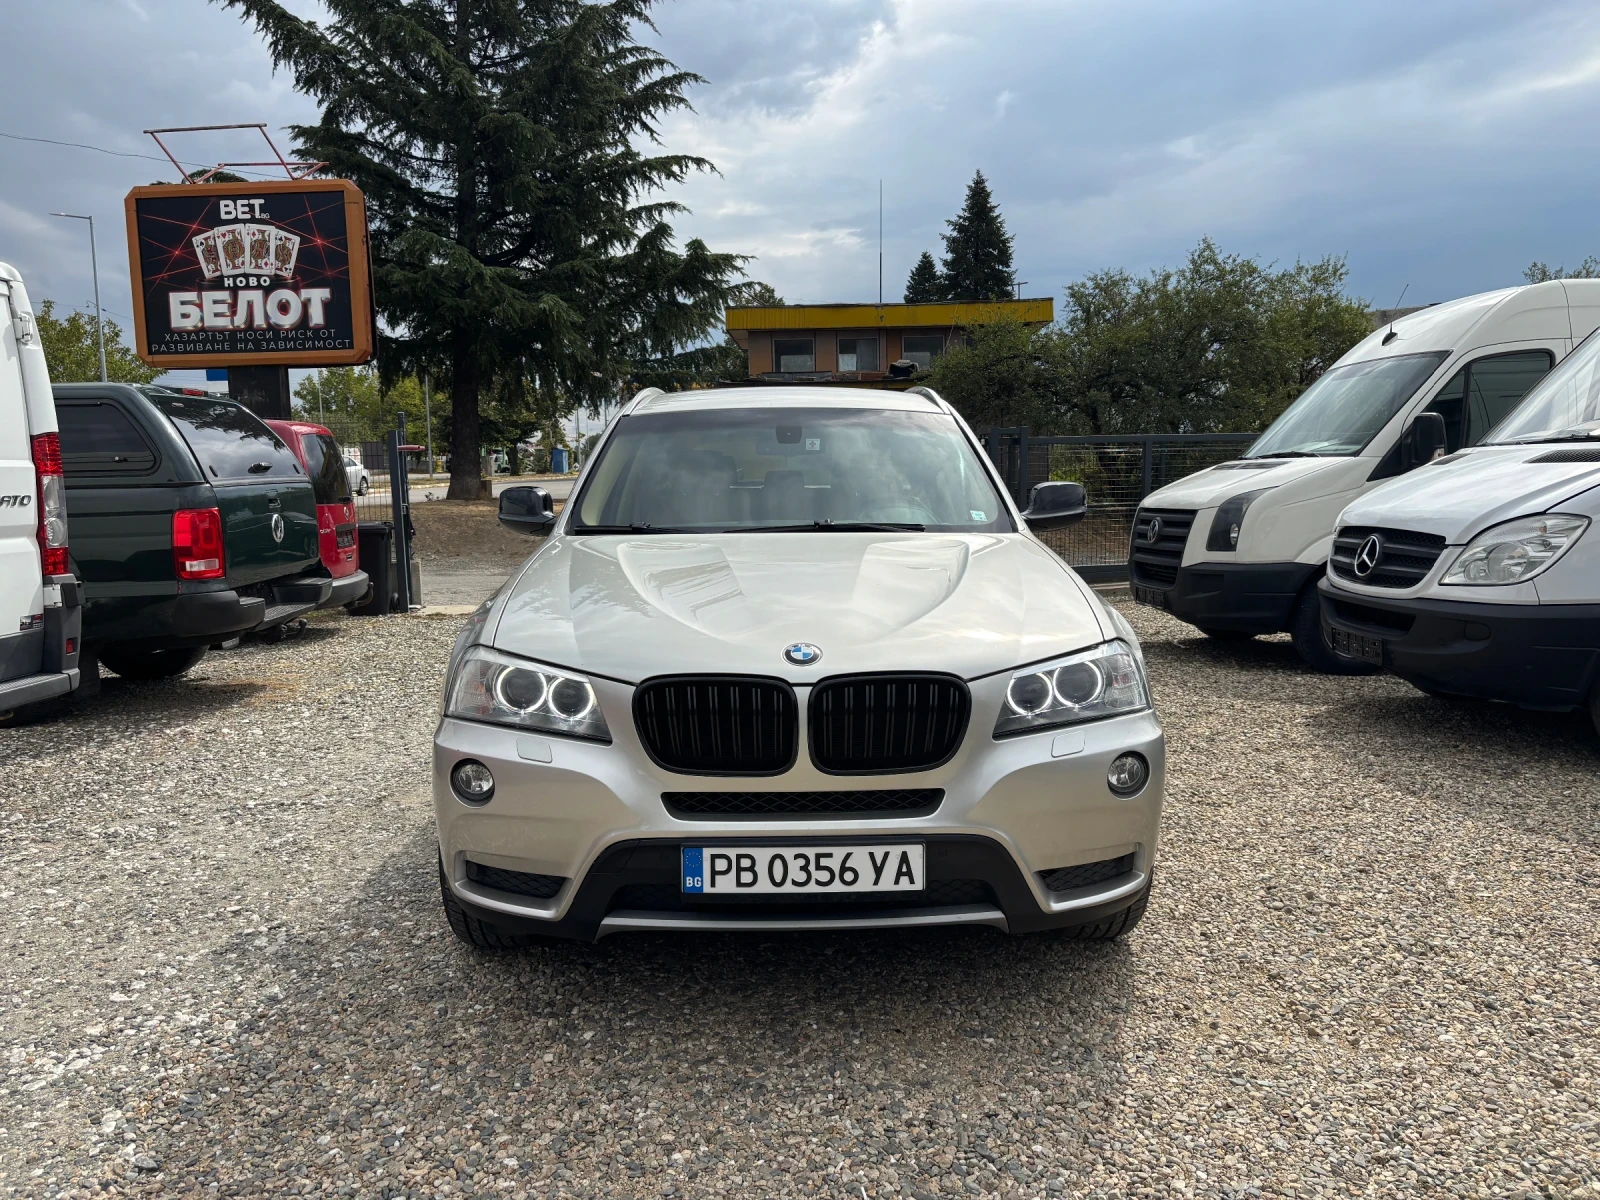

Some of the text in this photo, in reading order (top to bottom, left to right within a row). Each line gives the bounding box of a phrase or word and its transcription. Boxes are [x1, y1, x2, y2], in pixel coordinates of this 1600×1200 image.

[224, 276, 270, 287] НОВО
[169, 288, 331, 329] БЕЛОТ
[165, 329, 335, 341] ХАЗАРТЪТ НОСИ РИСК ОТ
[152, 340, 350, 352] РАЗВИВАНЕ НА ЗАВИСИМОСТ
[709, 851, 916, 888] PB 0356 YA
[686, 877, 702, 887] BG
